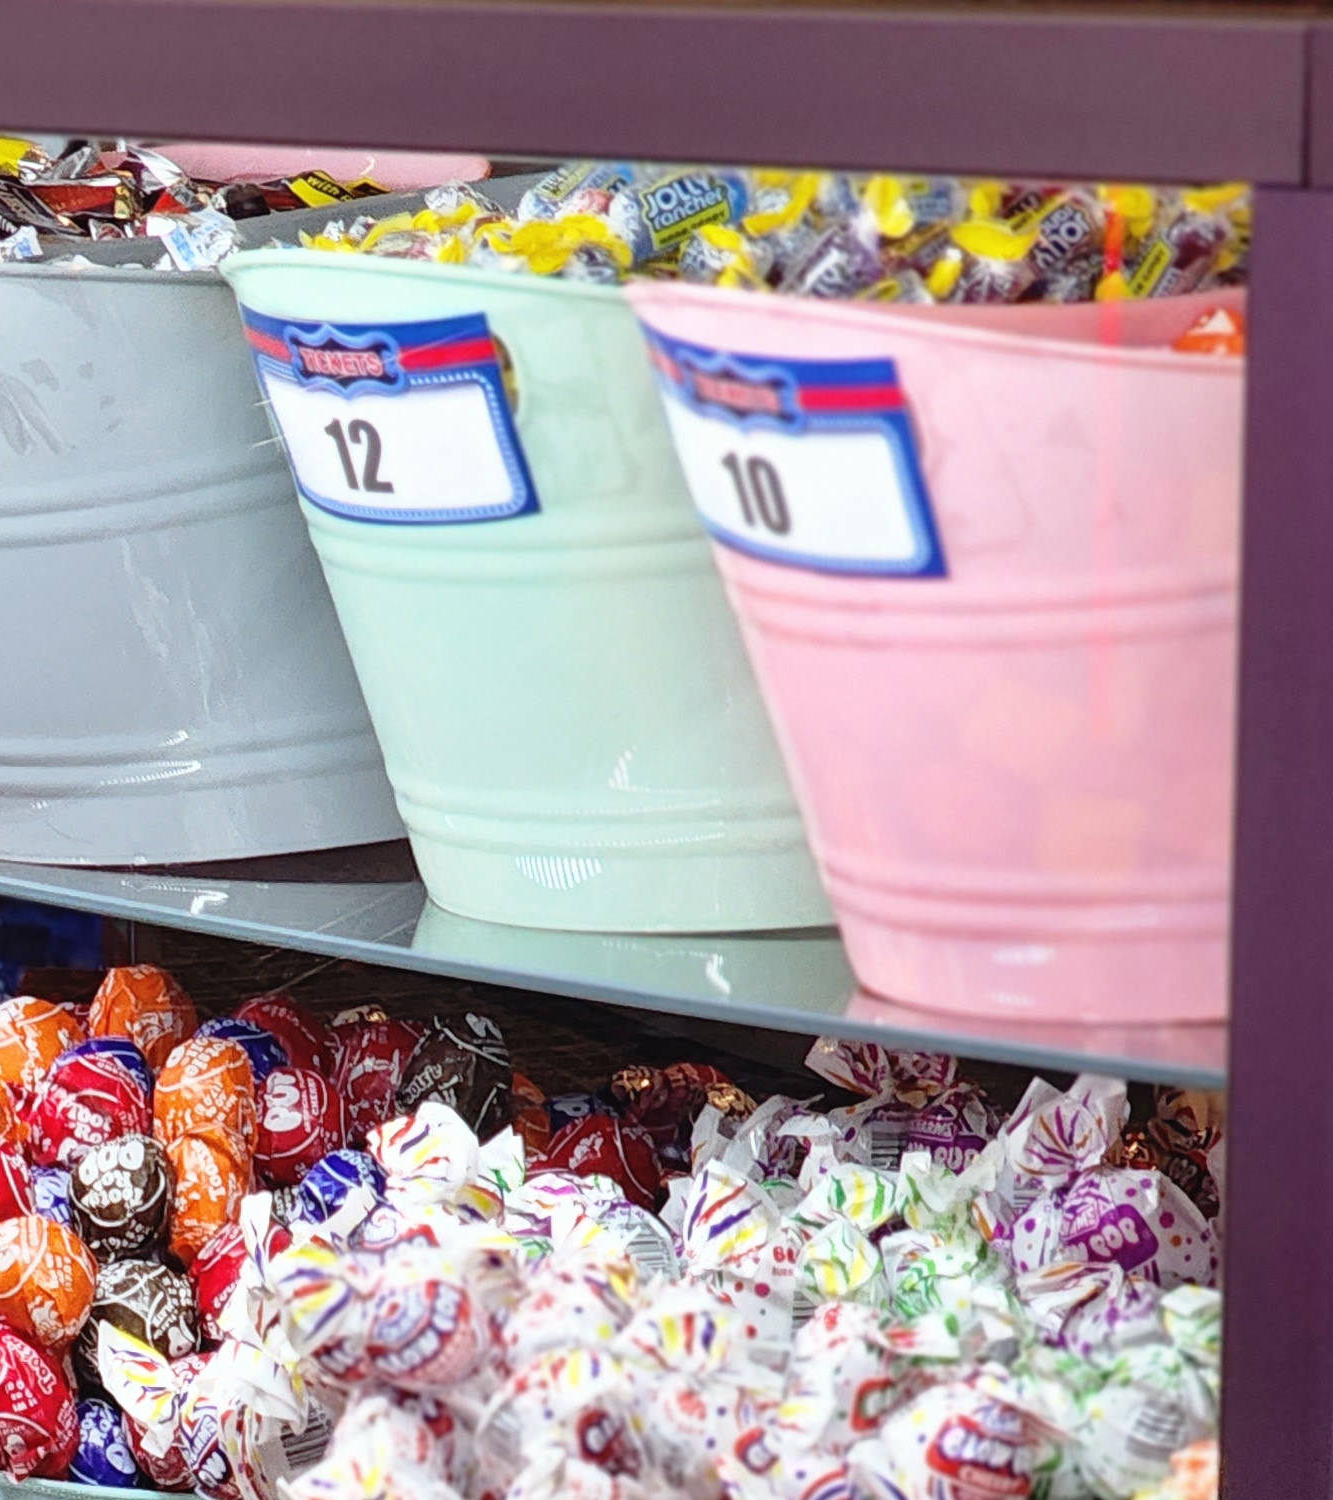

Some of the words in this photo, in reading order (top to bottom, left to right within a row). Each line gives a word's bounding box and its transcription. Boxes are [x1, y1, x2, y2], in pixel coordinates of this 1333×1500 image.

[644, 174, 712, 218] JOLLY
[298, 347, 383, 377] TICKETS
[324, 418, 395, 494] 12
[720, 451, 792, 537] 10
